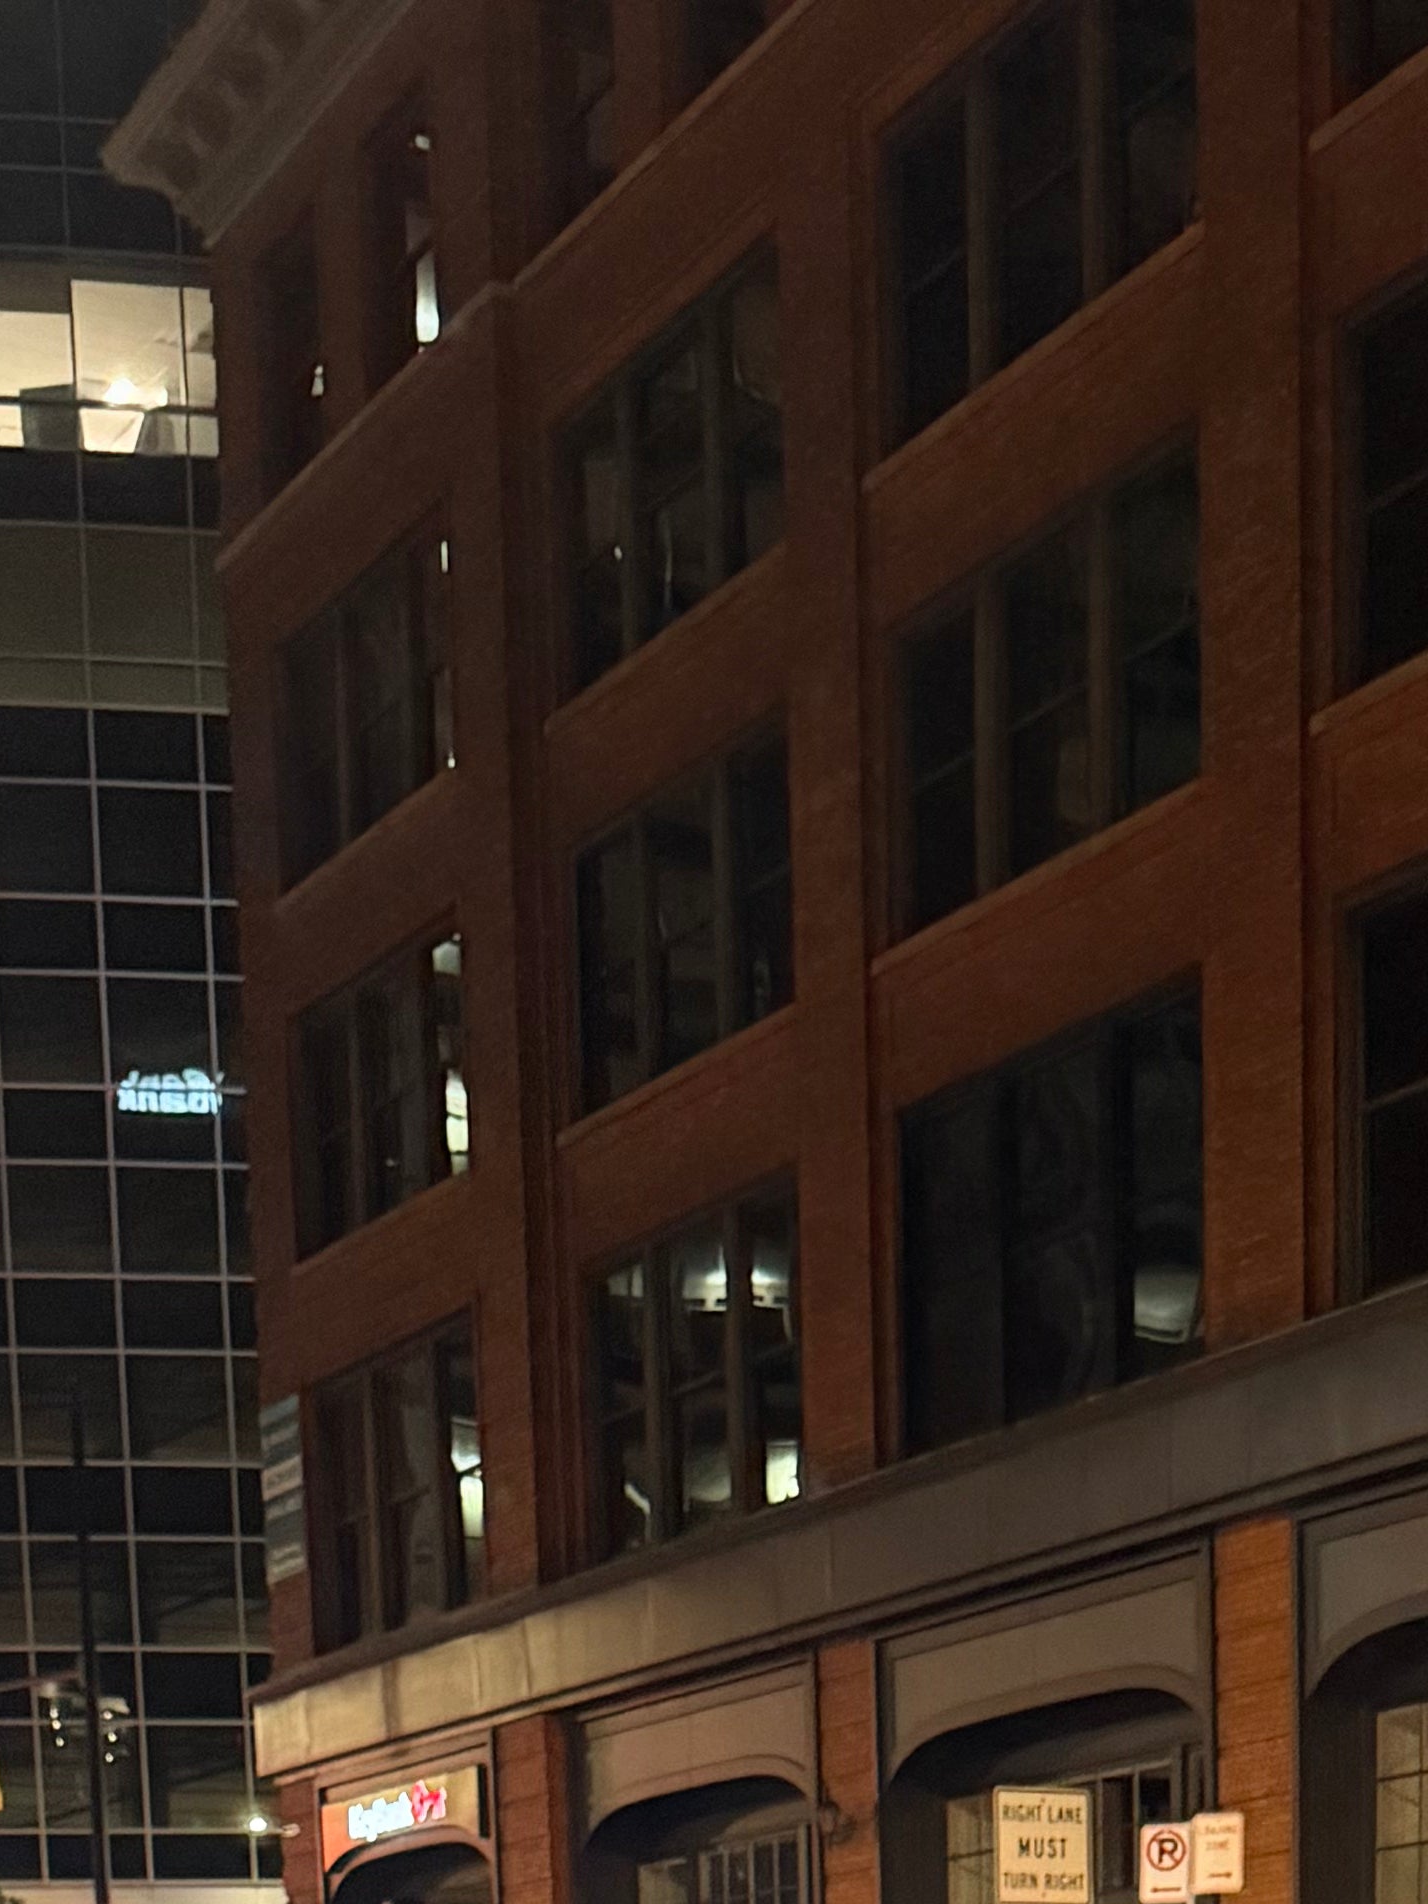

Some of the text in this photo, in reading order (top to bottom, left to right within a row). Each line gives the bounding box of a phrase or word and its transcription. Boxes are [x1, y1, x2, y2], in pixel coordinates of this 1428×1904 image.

[1002, 1803, 1083, 1825] RIGHT LANE
[1017, 1837, 1067, 1860] MUST
[1003, 1872, 1085, 1892] TURN RIGHT
